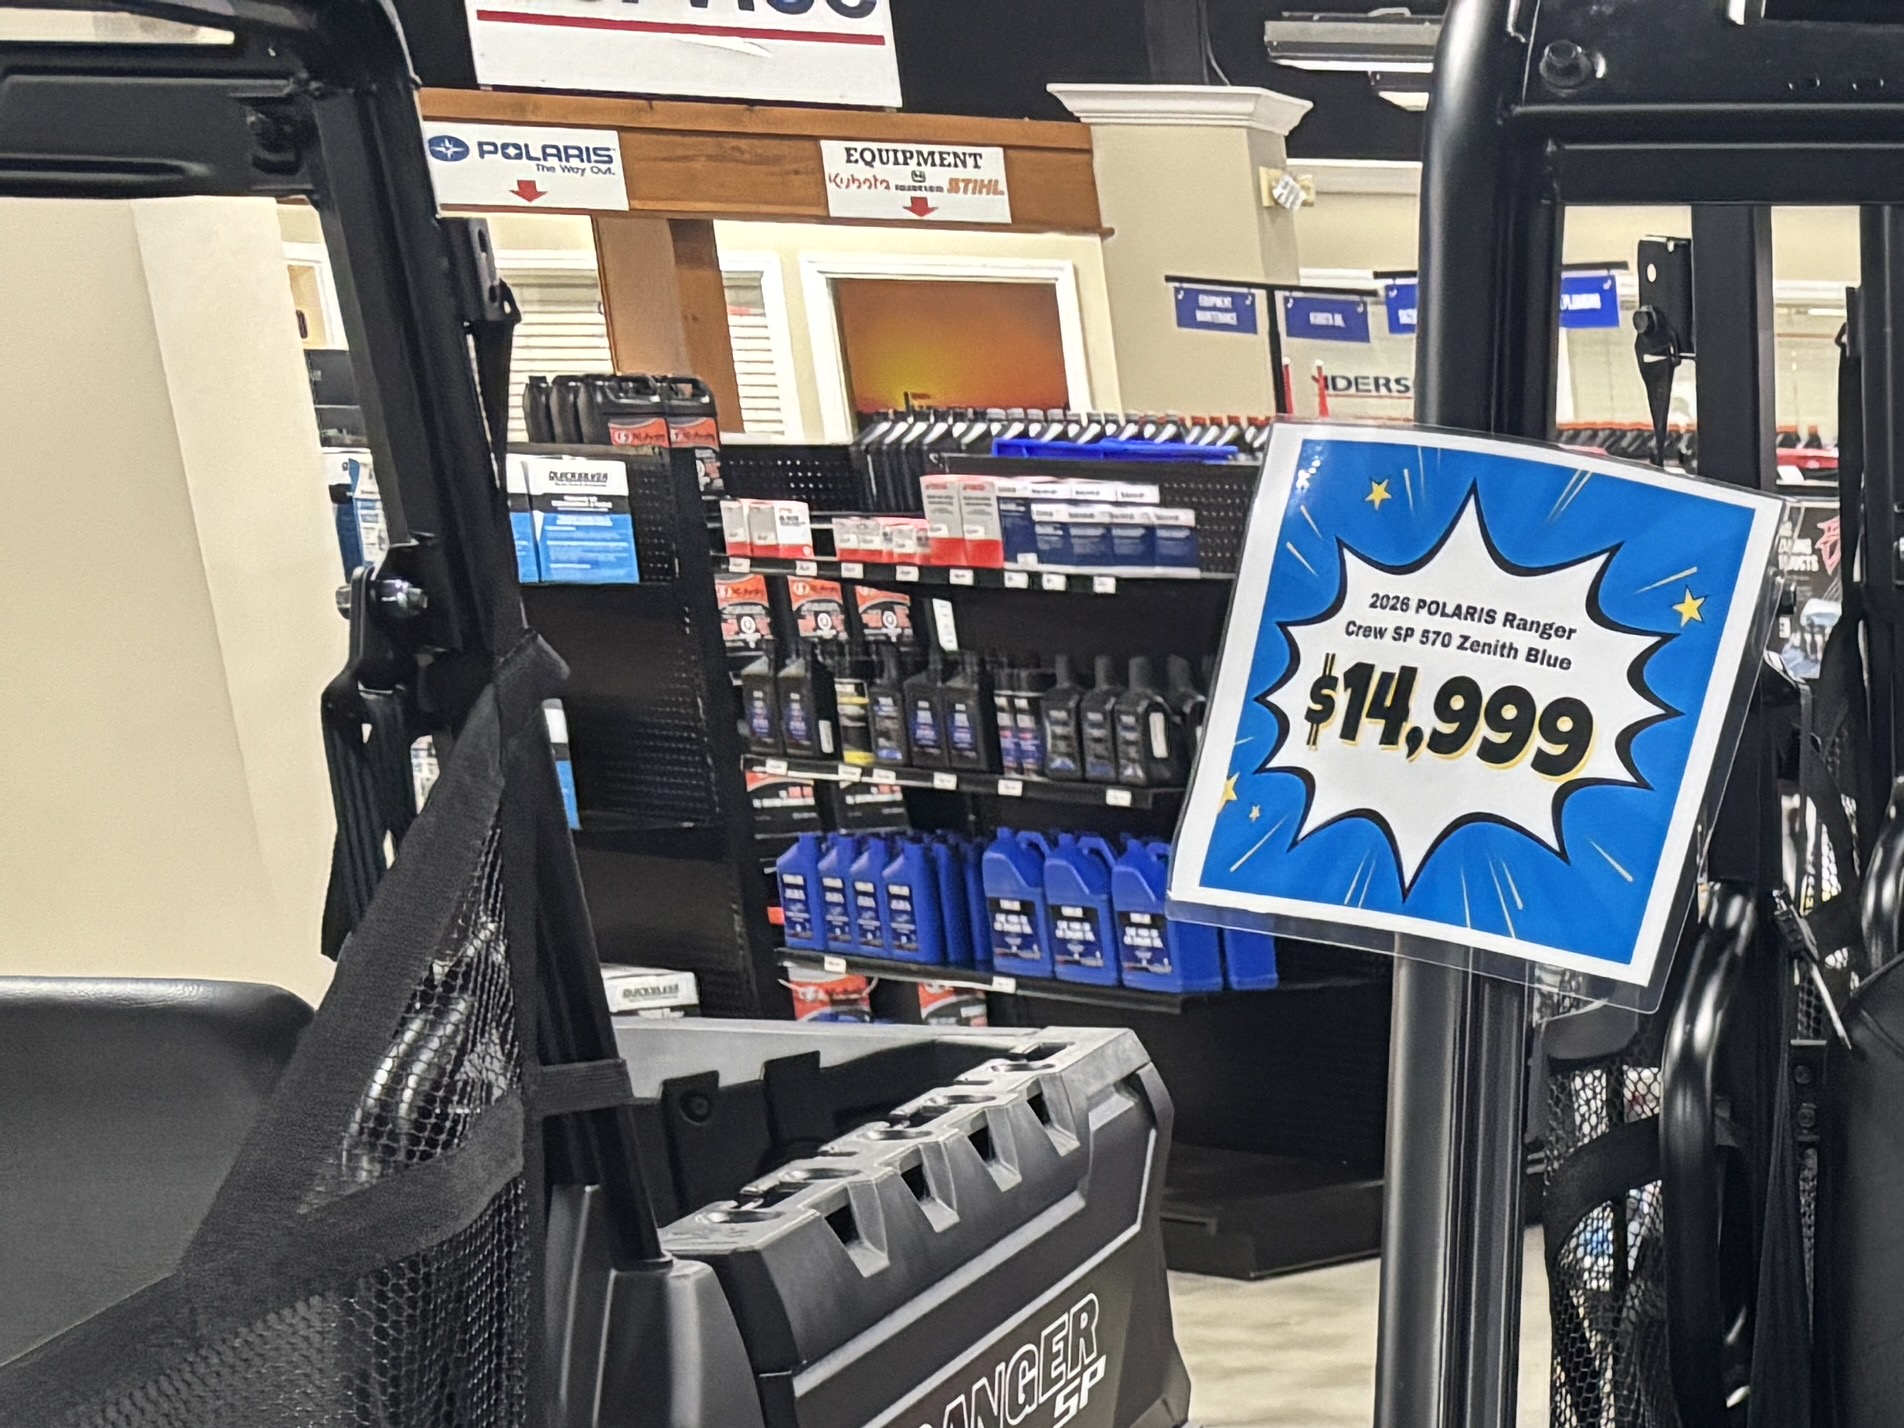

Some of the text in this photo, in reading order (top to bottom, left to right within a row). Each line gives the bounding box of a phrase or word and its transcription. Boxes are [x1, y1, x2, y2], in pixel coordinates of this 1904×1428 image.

[477, 141, 614, 165] POLARIS
[844, 146, 983, 169] EQUIPMENT
[536, 163, 556, 174] The
[559, 164, 586, 177] Way
[828, 172, 891, 191] Kubota
[947, 177, 1005, 196] STIHL
[1369, 593, 1577, 640] 2026 POLARIS Ranger
[1345, 620, 1572, 671] Crew SP 570 Zenith Blue
[1304, 653, 1594, 781] $14,999
